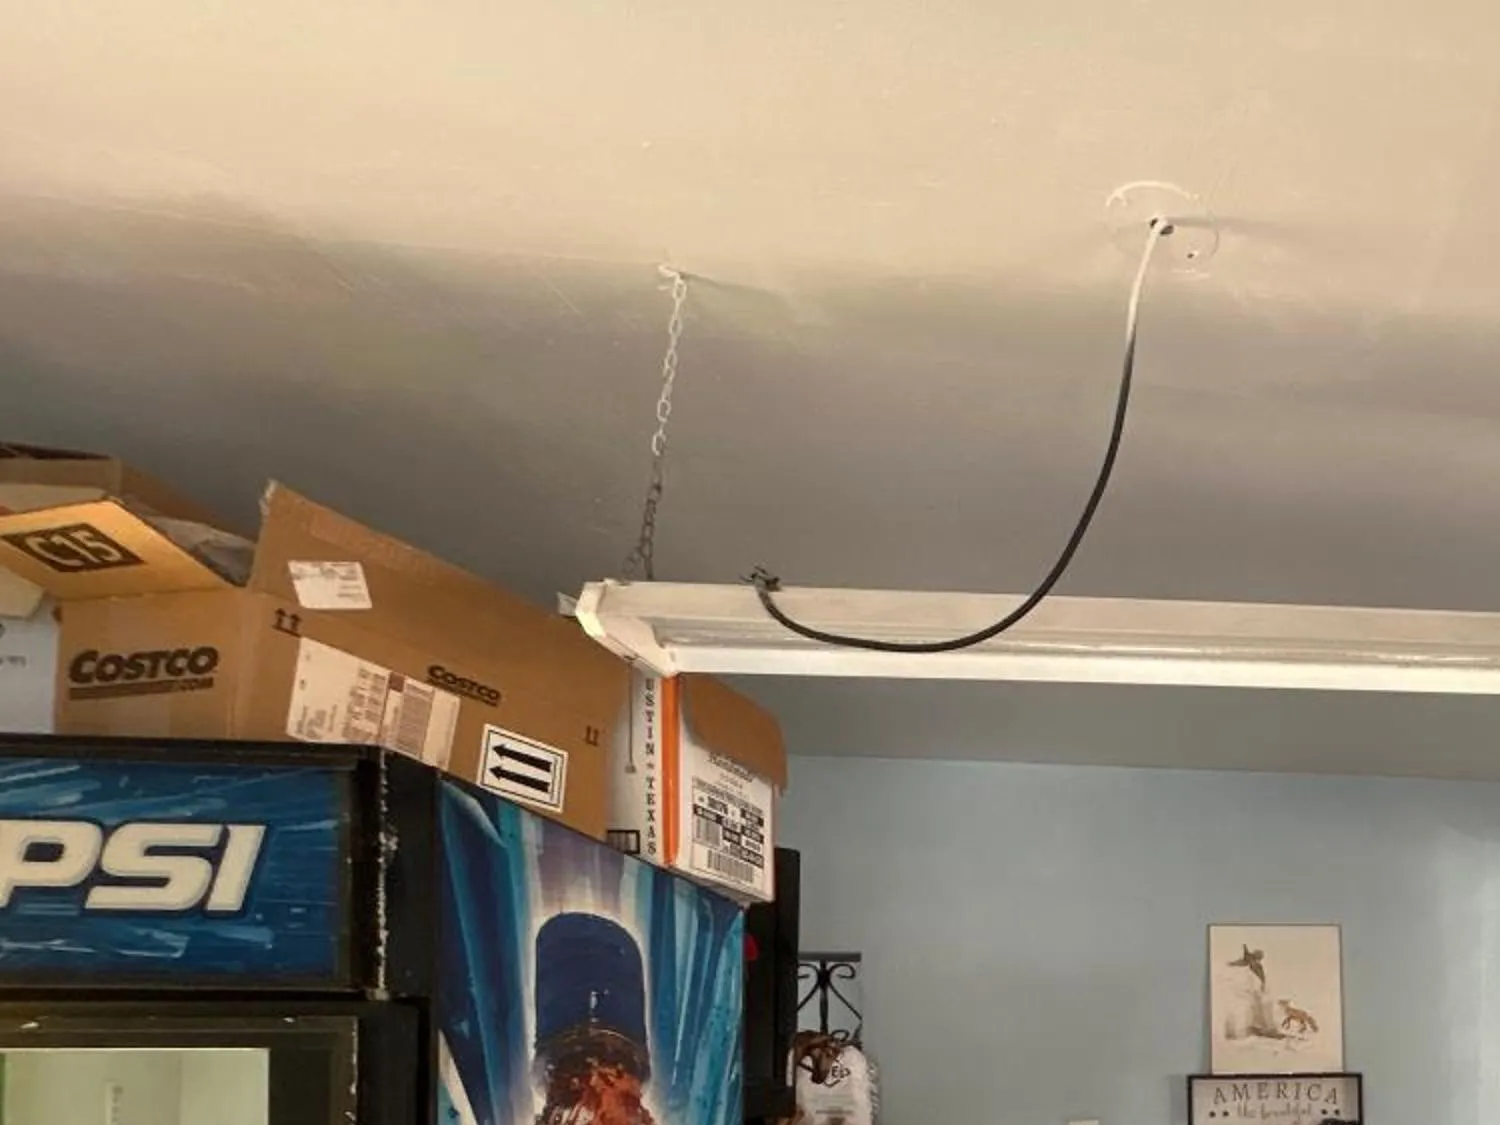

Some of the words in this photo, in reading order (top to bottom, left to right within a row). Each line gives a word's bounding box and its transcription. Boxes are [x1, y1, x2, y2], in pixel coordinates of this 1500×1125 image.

[68, 645, 219, 684] COSTCO
[426, 663, 501, 702] COSTCO
[645, 678, 656, 756] USTIN
[645, 776, 657, 856] TEXAS
[0, 819, 267, 912] PSI
[1213, 1081, 1339, 1106] AMERICA
